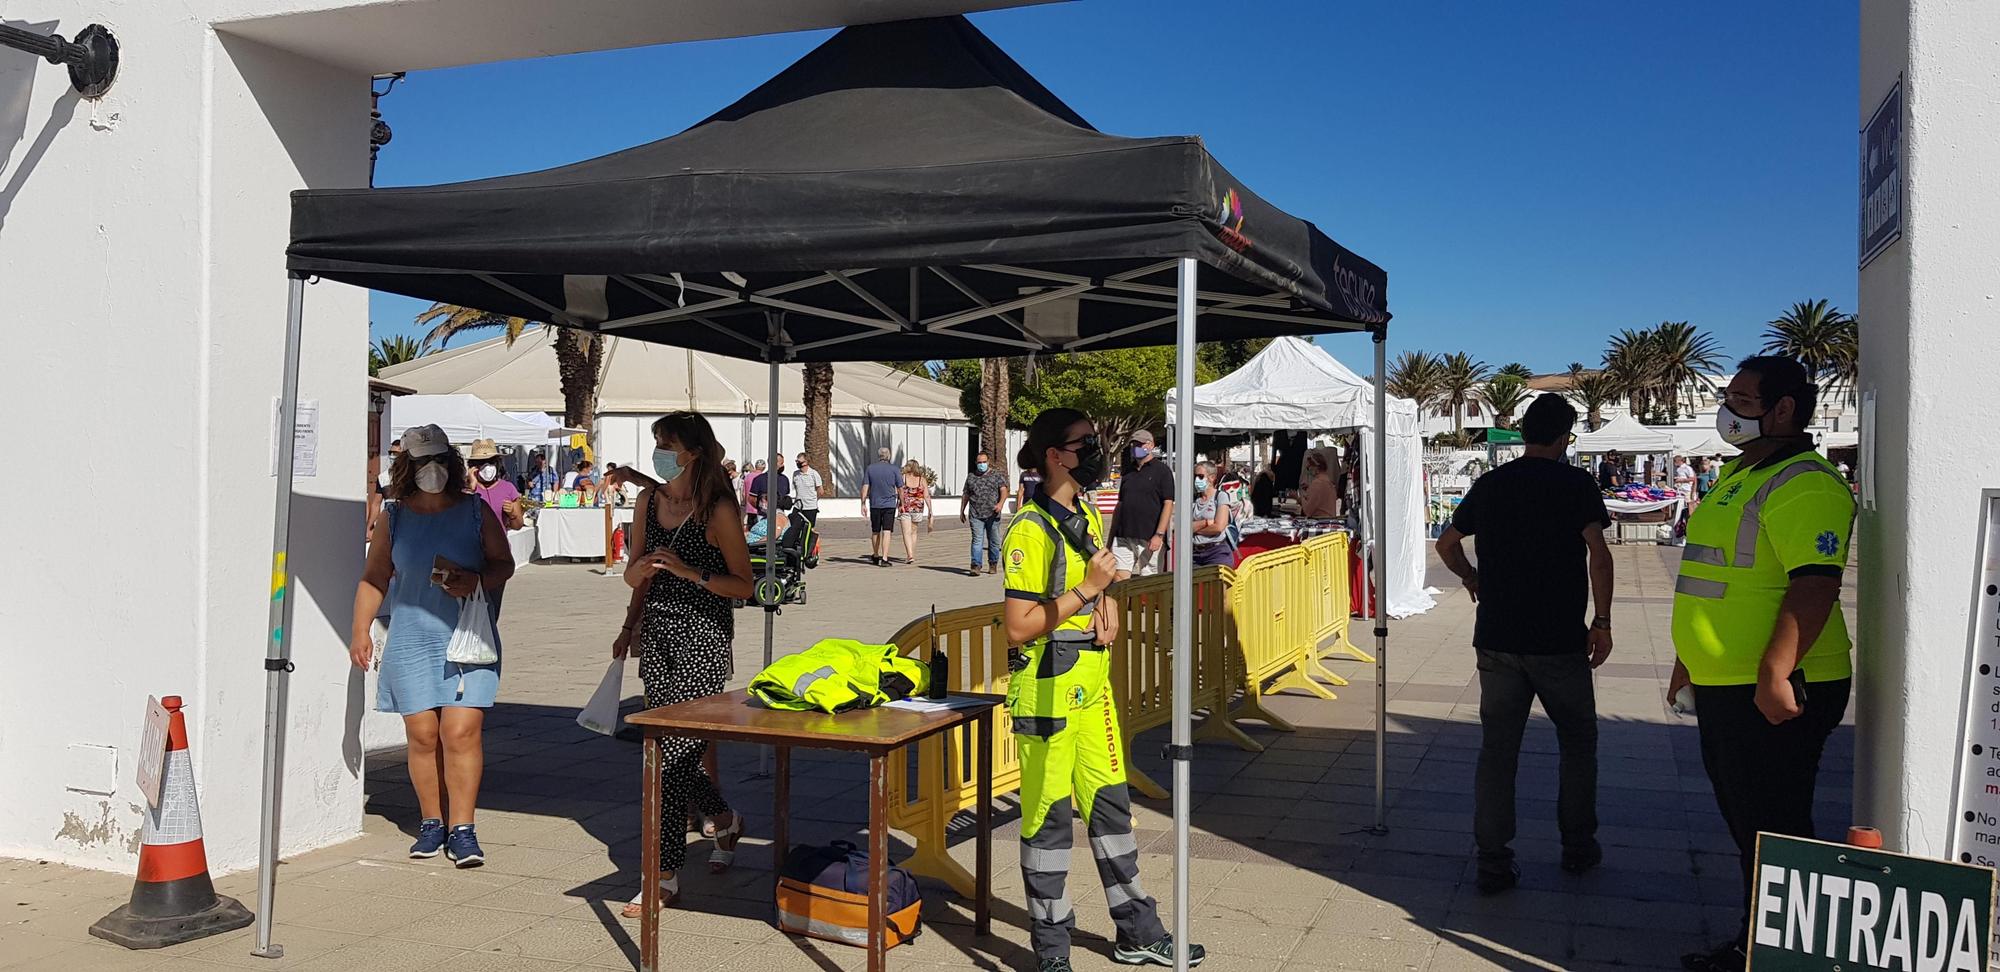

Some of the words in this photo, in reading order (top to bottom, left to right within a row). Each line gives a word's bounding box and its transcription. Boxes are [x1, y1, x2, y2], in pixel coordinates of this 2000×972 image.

[1880, 117, 1897, 166] WC
[1977, 811, 1997, 826] No
[1755, 864, 1980, 972] ENTRADA
